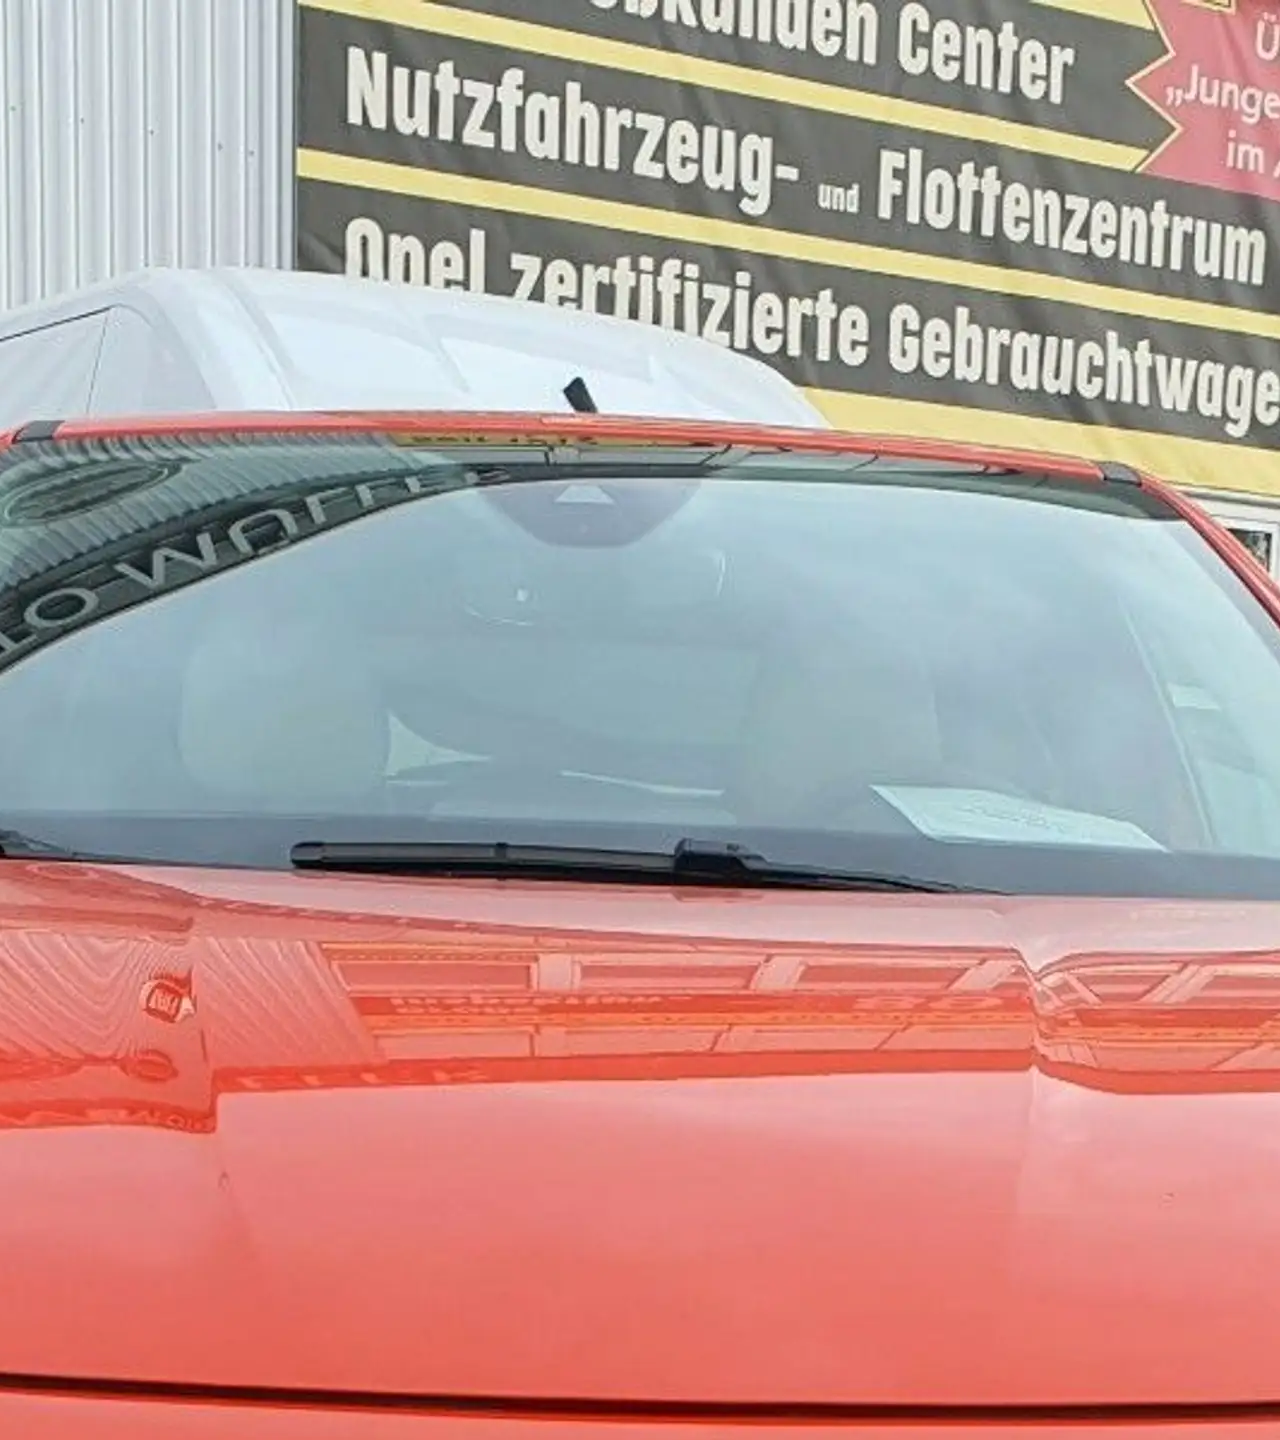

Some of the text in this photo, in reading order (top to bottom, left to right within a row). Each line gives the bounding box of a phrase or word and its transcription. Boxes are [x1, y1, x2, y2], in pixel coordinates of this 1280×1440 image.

[897, 0, 1075, 104] Center
[345, 45, 1267, 286] Nutzfahrzeug- und Flottenzentrum
[1225, 131, 1264, 175] im
[510, 251, 869, 367] zertifizierte
